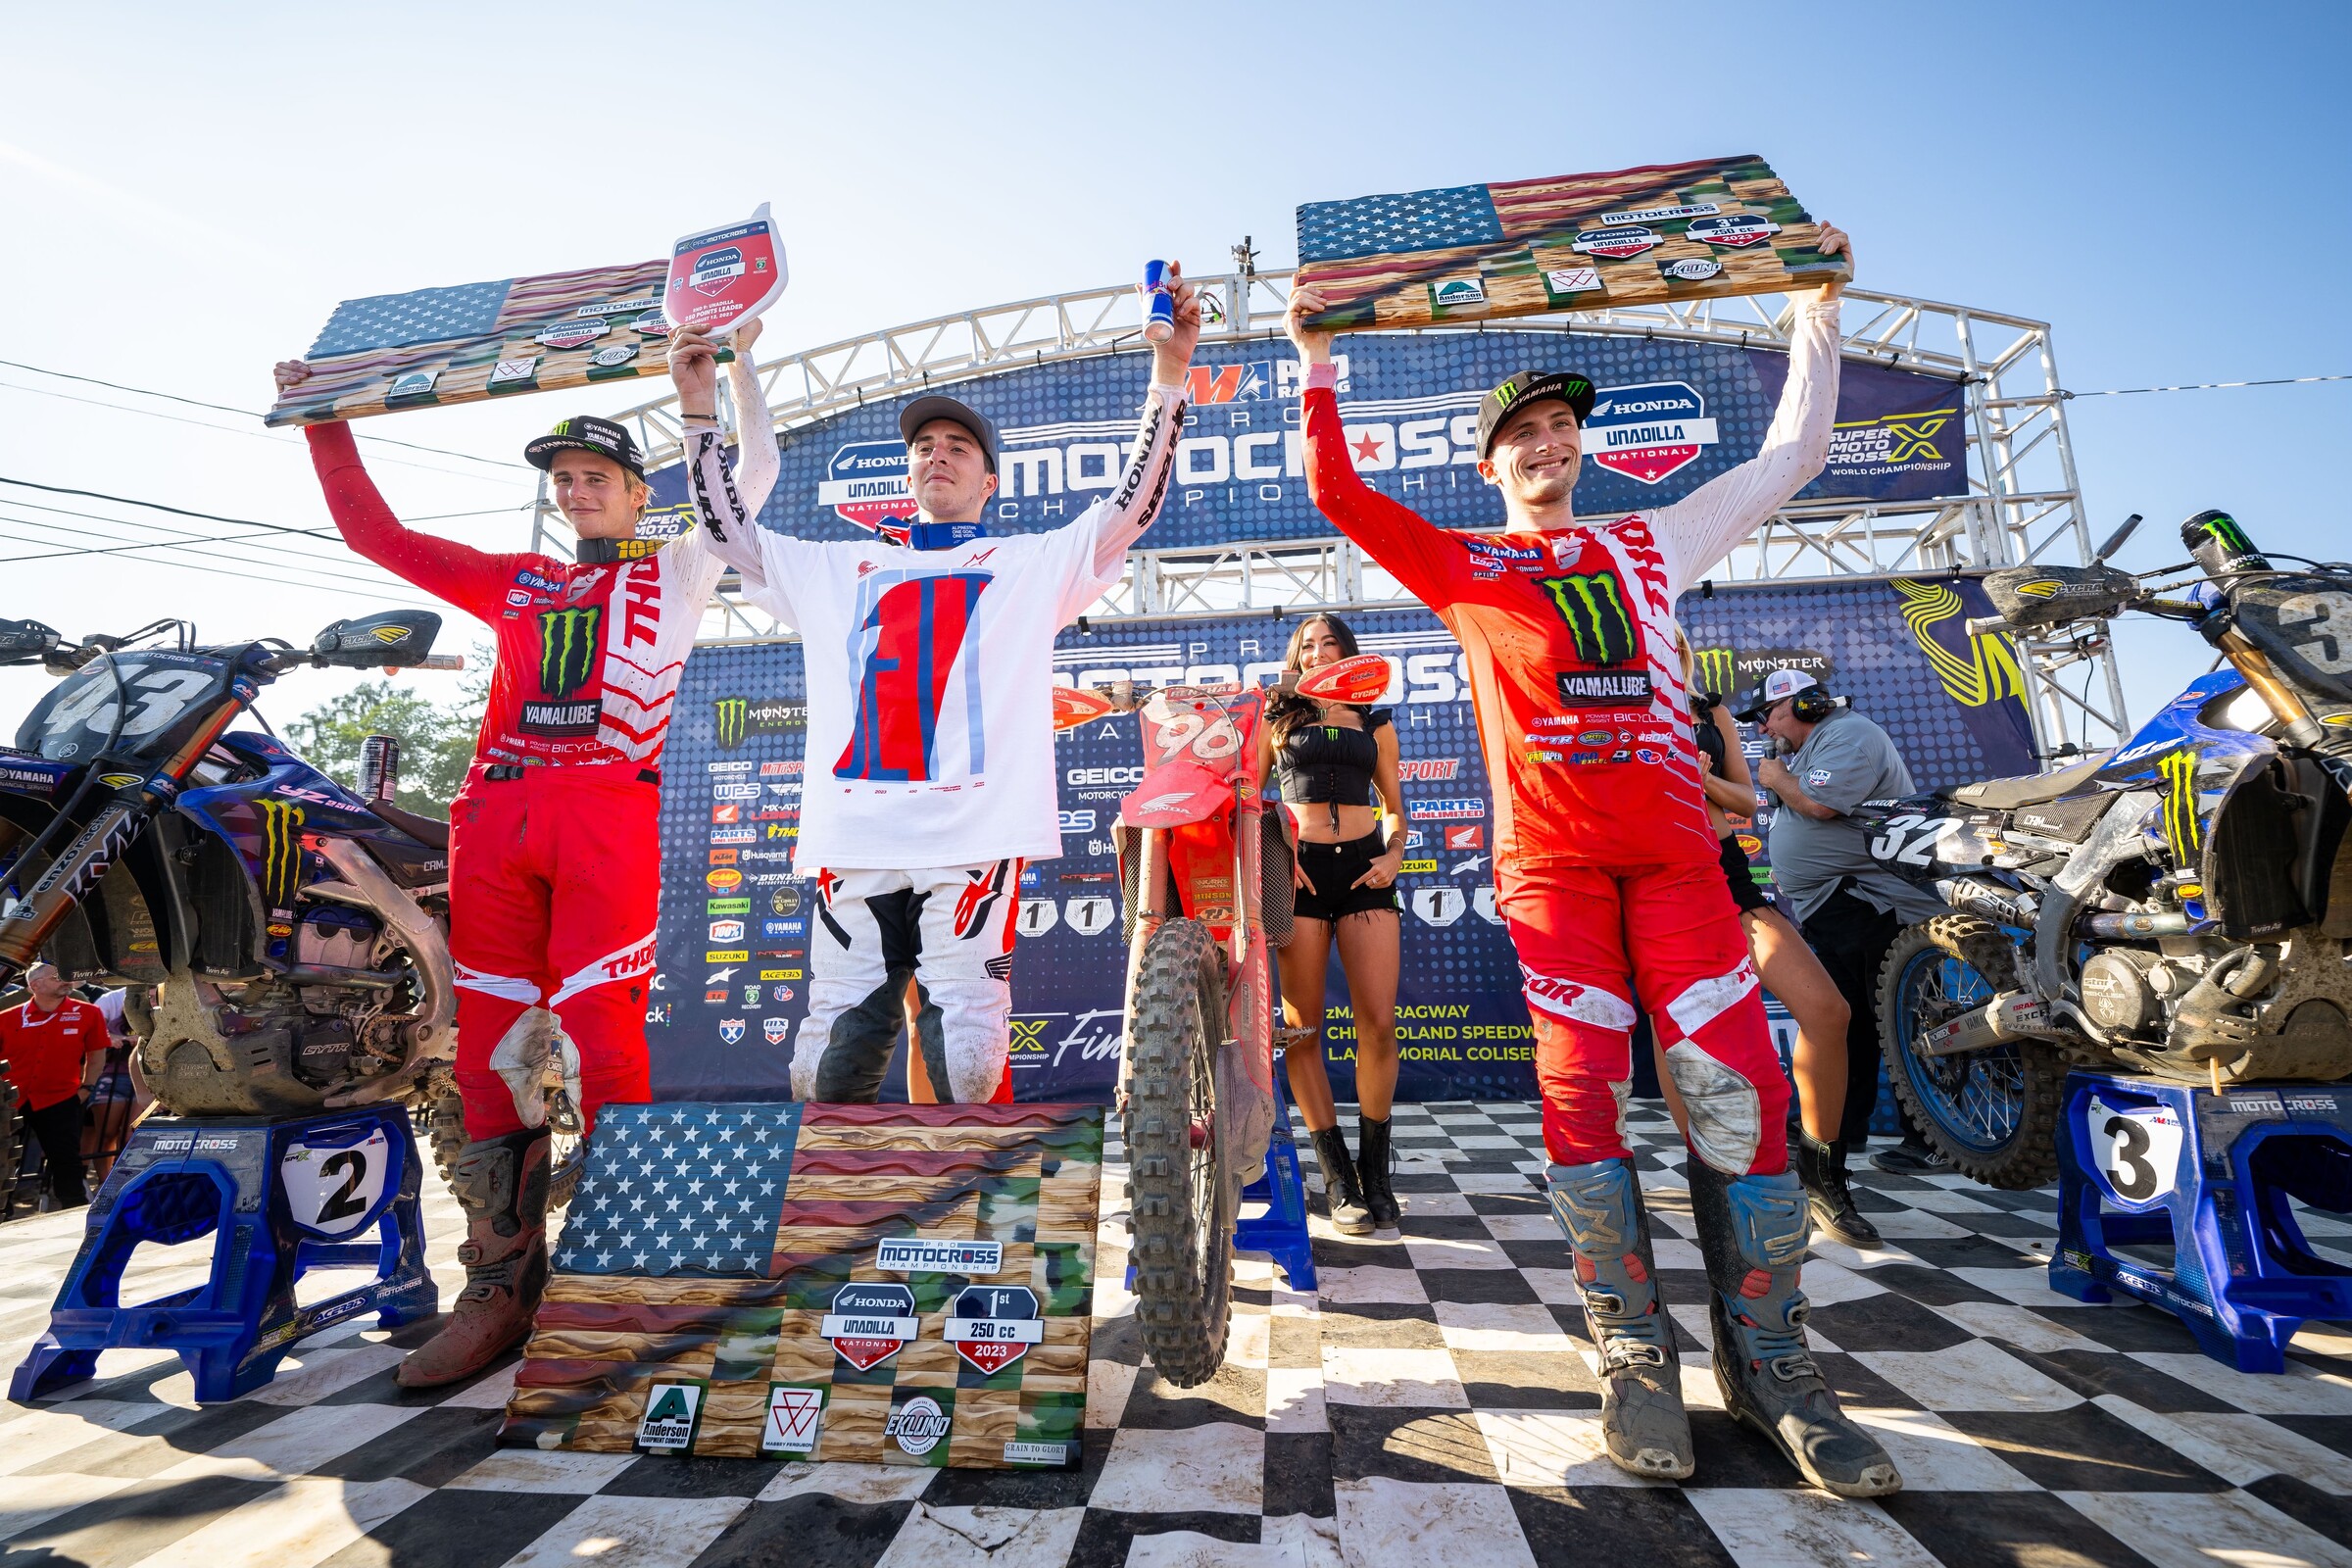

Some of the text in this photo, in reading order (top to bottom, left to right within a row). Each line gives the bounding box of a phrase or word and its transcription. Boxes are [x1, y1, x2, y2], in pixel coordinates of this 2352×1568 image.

[1605, 205, 1716, 222] MOTOCROSS
[1716, 217, 1740, 227] 3rd
[1593, 238, 1642, 247] UNADILLA
[1722, 233, 1753, 242] 2023
[707, 254, 737, 266] HONDA
[702, 267, 731, 280] UNADILLA
[1664, 263, 1722, 276] EKLUND
[697, 309, 717, 318] POINTS
[718, 304, 743, 313] LEADER
[709, 299, 734, 309] UNADILLA
[1519, 382, 1562, 405] YAMAHA
[1613, 398, 1694, 415] HONDA
[593, 424, 621, 440] YAMAHA
[1606, 424, 1686, 447] UNADILLA
[1830, 427, 1892, 442] SUPER
[539, 441, 584, 450] YAMAHA
[587, 432, 618, 447] YAMALUBE
[1829, 439, 1889, 454] MOTO
[1115, 405, 1163, 512] HONDA
[1608, 448, 1690, 461] NATIONAL
[1826, 450, 1891, 465] CROSS
[1831, 463, 1951, 476] WORLD CHAMPIONSHIP
[717, 443, 746, 526] ONDA
[2055, 583, 2104, 595] CYCRA
[510, 593, 529, 604] 100%
[342, 634, 377, 645] CYCRA
[2278, 591, 2352, 676] 3
[1339, 655, 1383, 671] HONDA
[1738, 656, 1826, 672] MONSTER
[1351, 687, 1380, 700] CYCRA
[1564, 676, 1649, 697] YAMALUBE
[43, 664, 215, 736] 43
[525, 704, 595, 726] YAMALUBE
[1543, 715, 1580, 726] YAMAHA
[1614, 713, 1674, 723] BICYCLES
[1154, 710, 1245, 762] 96
[1524, 734, 1575, 745] GYTR
[709, 761, 752, 772] GEICO
[9, 769, 54, 784] YAMAHA
[714, 783, 760, 800] WPS
[1137, 805, 1193, 817] HONDA
[1411, 799, 1483, 812] PARTS
[1412, 810, 1483, 819] UNLIMITED
[1870, 814, 1964, 866] 32
[37, 805, 120, 892] enzoracing
[751, 852, 787, 861] Husqvarna
[1194, 892, 1232, 901] HINSON
[710, 901, 749, 911] Kawasaki
[1429, 891, 1451, 918] 1ST
[1081, 901, 1102, 927] 1ST
[714, 925, 741, 938] 100%
[774, 922, 802, 931] YAMAHA
[2250, 925, 2270, 934] Twin
[205, 966, 219, 975] Twin
[2083, 990, 2126, 999] REKLUSE
[302, 1042, 350, 1056] GYTR
[2231, 1099, 2338, 1111] MOTOCROSS
[153, 1139, 239, 1151] MOTOCROSS
[2104, 1116, 2157, 1200] 3
[316, 1150, 367, 1225] 2
[880, 1248, 999, 1264] MOTOCROSS
[879, 1261, 998, 1271] CHAMPIONSHIP
[377, 1278, 423, 1299] MOTOCROSS
[316, 1298, 363, 1322] ACERBIS
[855, 1298, 907, 1308] HONDA
[988, 1290, 1010, 1318] 1st
[2167, 1292, 2214, 1318] MOTOCROSS
[844, 1319, 895, 1335] UNADILLA
[970, 1323, 994, 1338] 250
[840, 1340, 894, 1348] NATIONAL
[974, 1345, 1007, 1357] 2023
[643, 1423, 689, 1438] Anderson
[884, 1416, 952, 1436] EKLUND
[1005, 1443, 1029, 1452] GRAIN
[1041, 1446, 1065, 1454] GLORY
